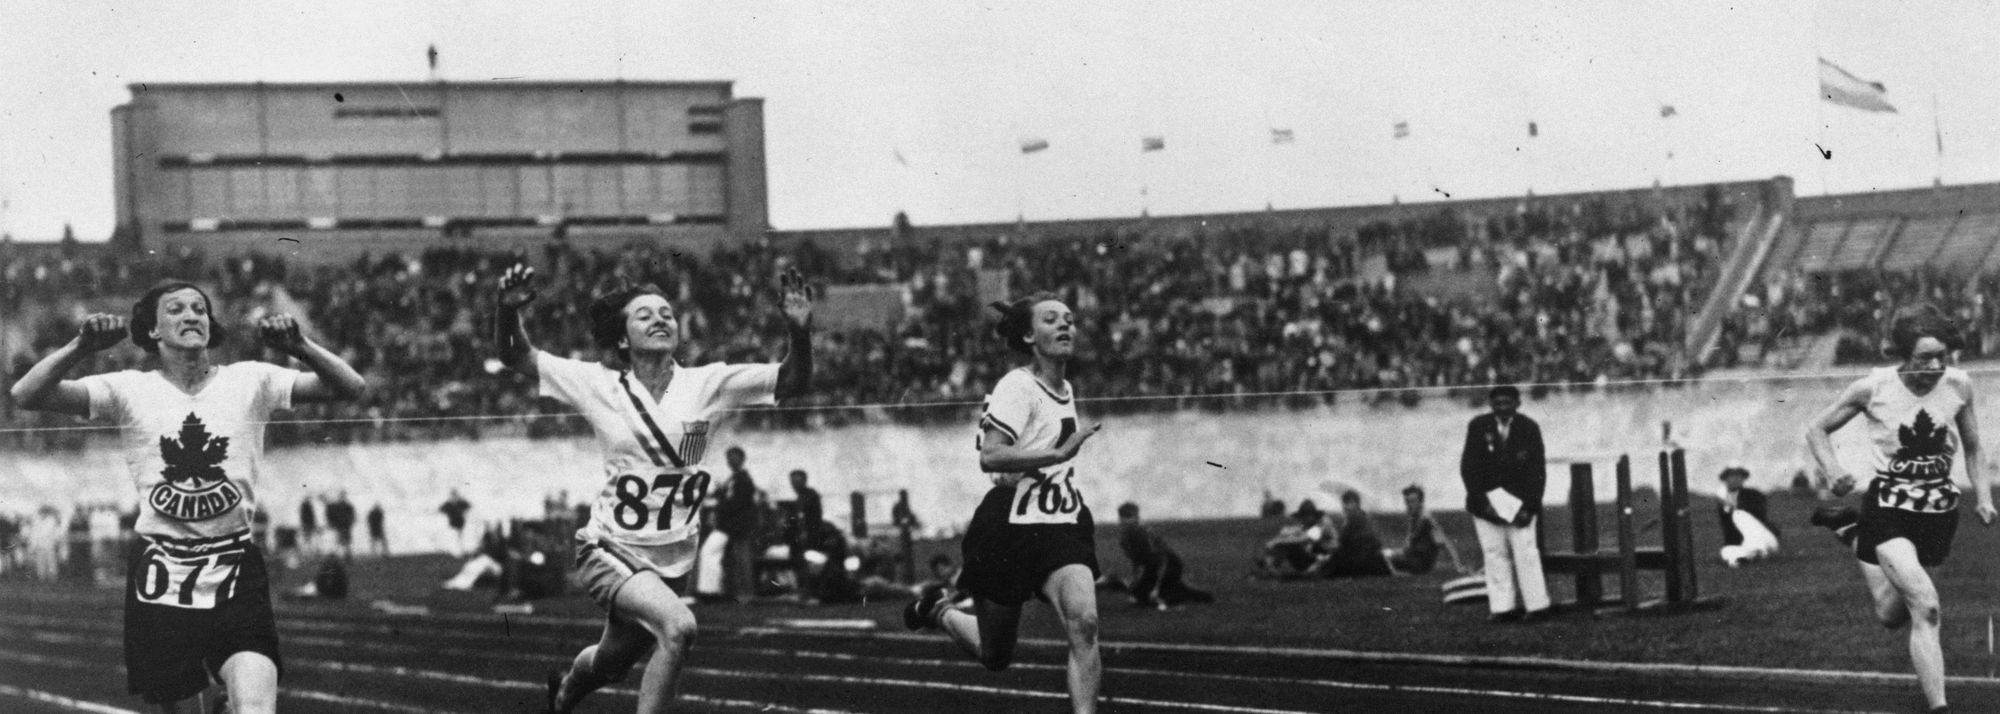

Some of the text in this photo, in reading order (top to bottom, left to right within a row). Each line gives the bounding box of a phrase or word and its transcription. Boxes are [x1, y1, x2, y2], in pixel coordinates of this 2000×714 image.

[1891, 457, 1949, 476] CANAD
[154, 485, 239, 518] CANADA
[613, 470, 711, 531] 879
